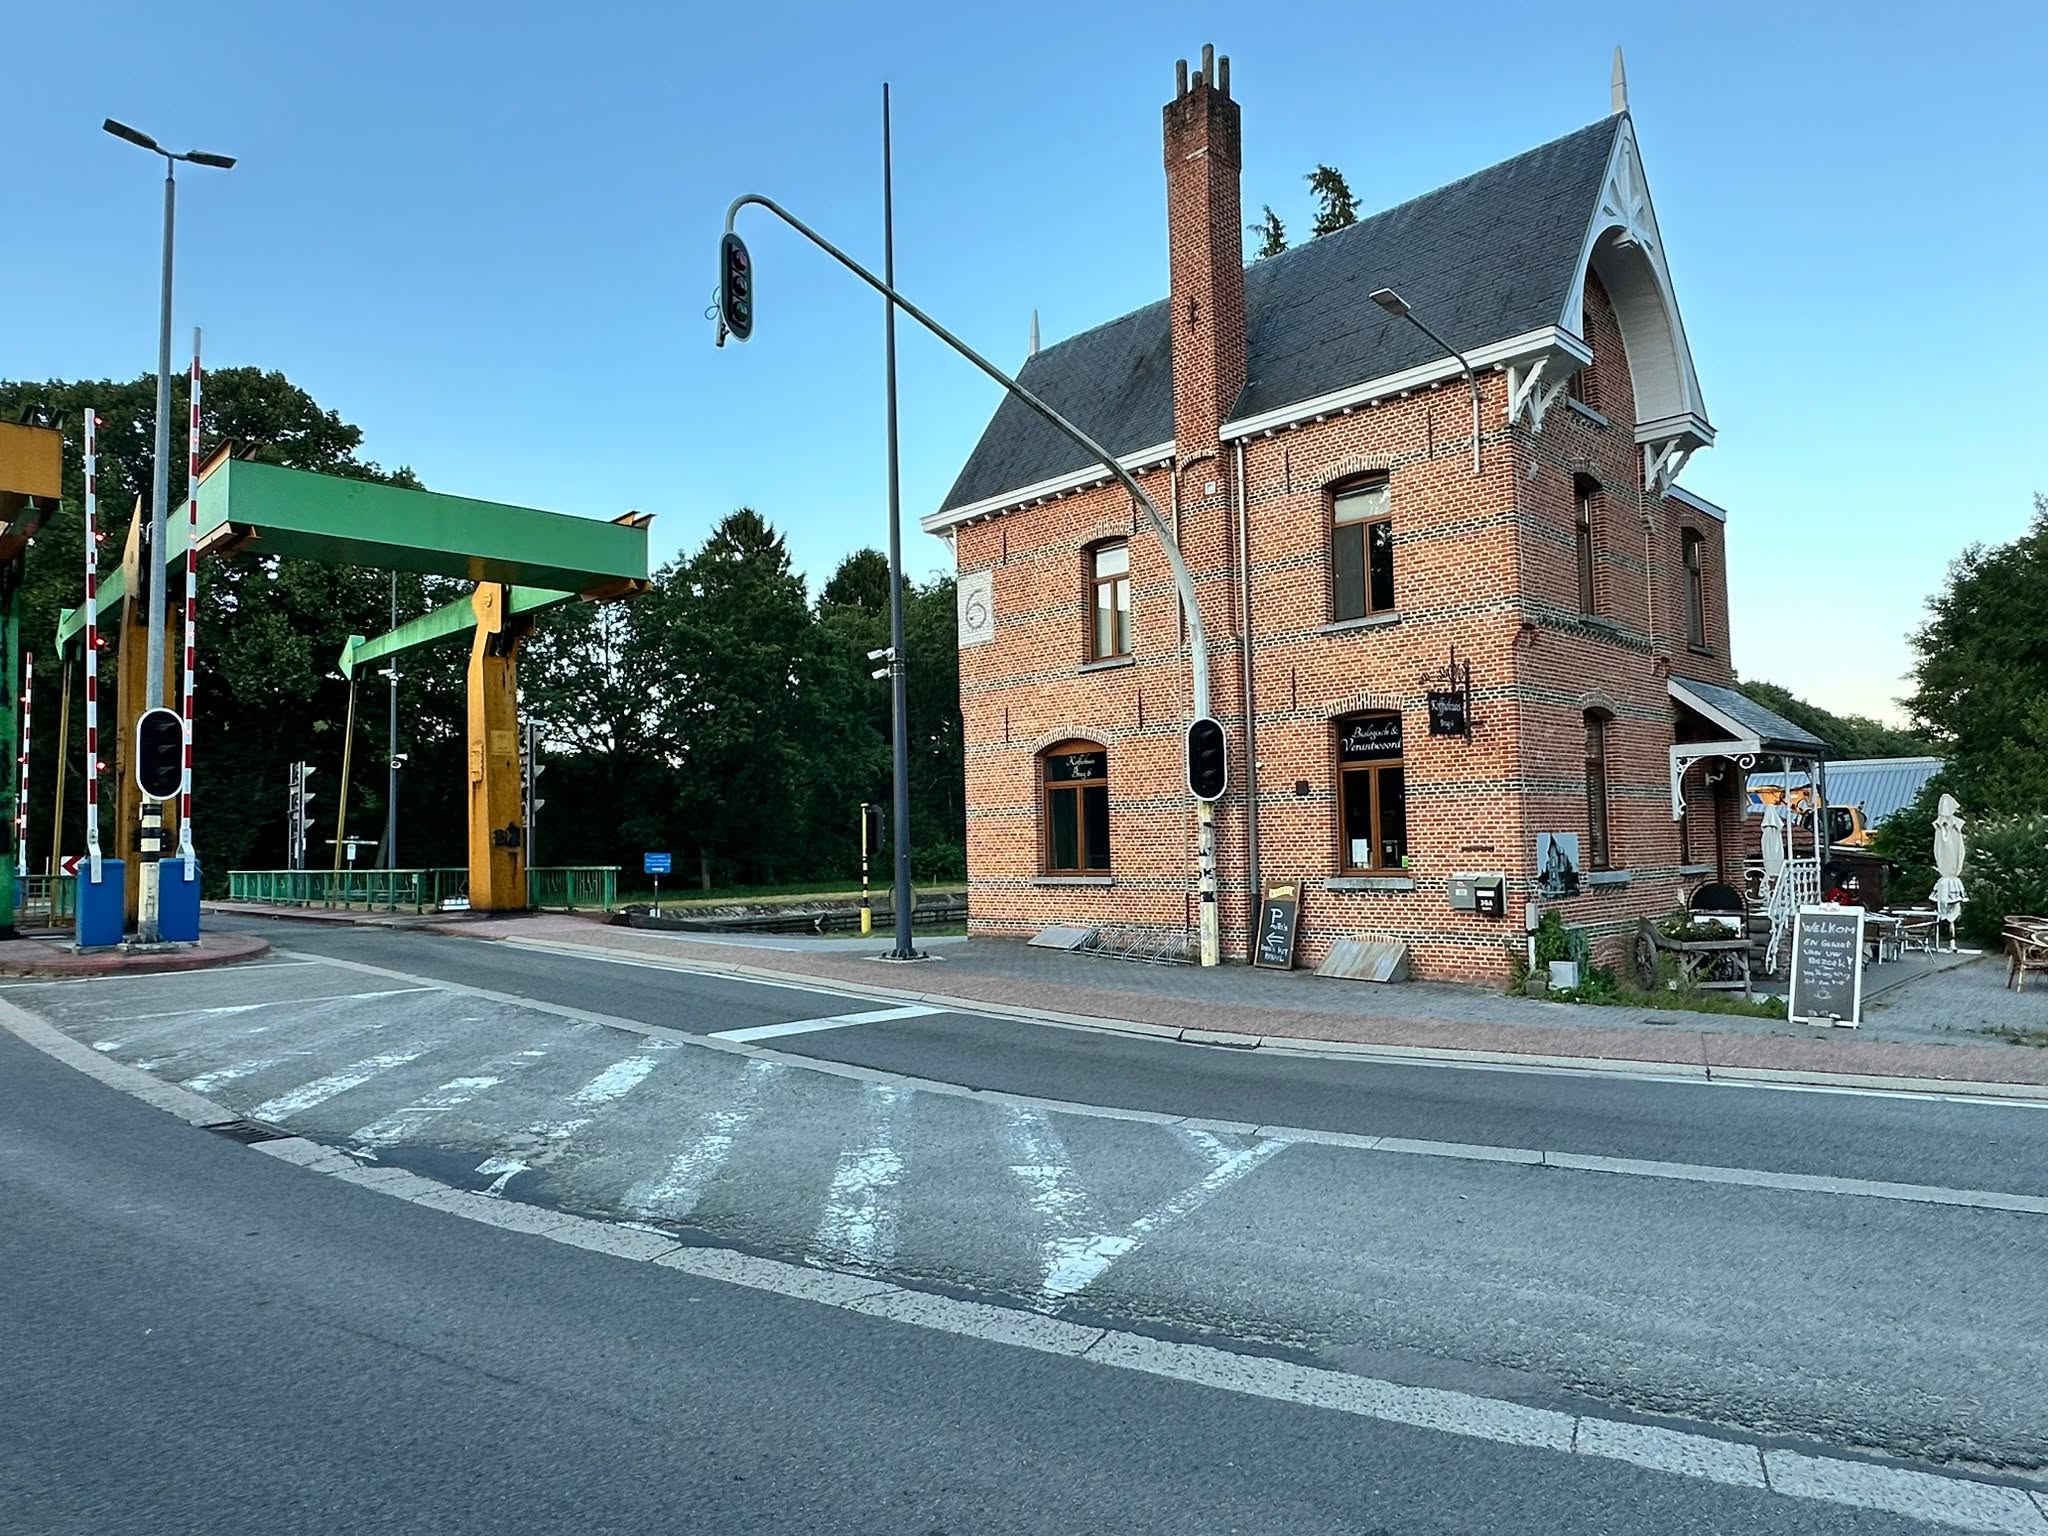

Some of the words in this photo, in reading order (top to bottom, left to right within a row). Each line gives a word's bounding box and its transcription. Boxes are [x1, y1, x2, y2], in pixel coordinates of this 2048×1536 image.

[965, 588, 987, 630] 6
[1340, 737, 1402, 752] Verantwoord
[1270, 908, 1284, 923] P
[1802, 921, 1856, 935] WELKOM
[1803, 938, 1819, 947] EN
